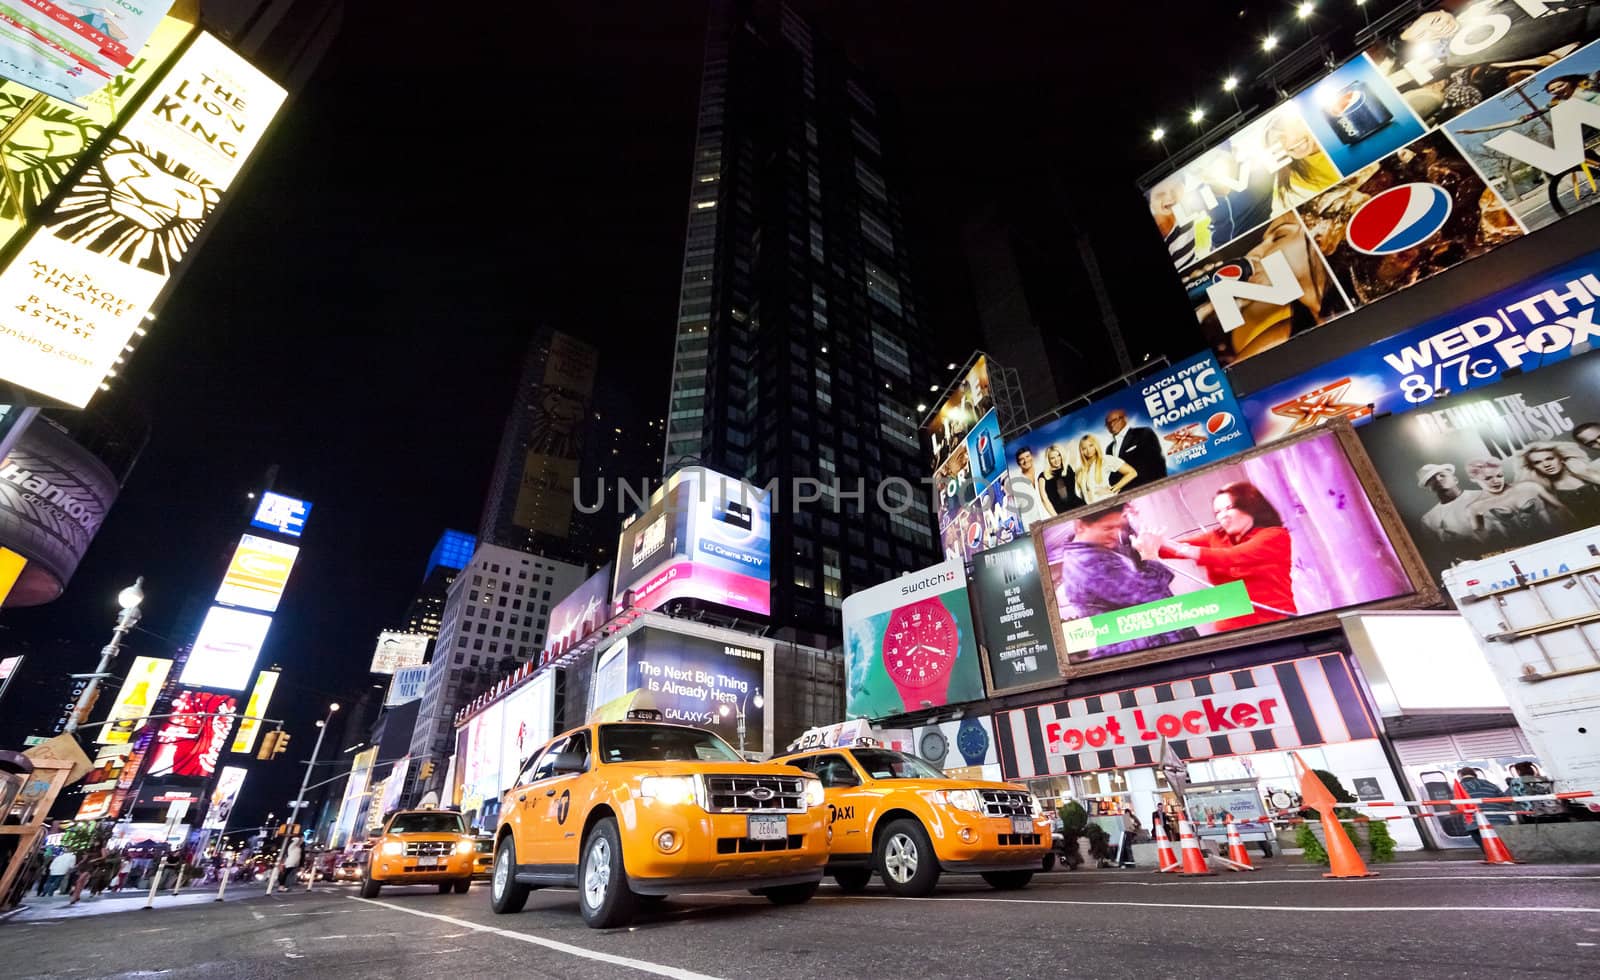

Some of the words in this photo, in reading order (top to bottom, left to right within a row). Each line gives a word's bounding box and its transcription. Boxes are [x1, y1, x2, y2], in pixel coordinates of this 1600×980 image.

[175, 80, 245, 133] LION
[201, 73, 246, 111] THE
[152, 94, 238, 158] KING
[29, 260, 135, 311] MINSKOFF
[33, 269, 122, 317] THEATRE
[15, 305, 67, 330] 45TH
[1495, 308, 1600, 367] FOX
[1142, 376, 1175, 395] CATCH
[1178, 359, 1211, 379] EVERY
[1144, 368, 1220, 417] EPIC
[1153, 390, 1224, 428] MOMENT
[1214, 430, 1242, 446] pepsi
[0, 464, 97, 535] Hankook
[703, 543, 714, 551] LG
[715, 546, 741, 559] Cinema
[902, 574, 945, 596] swatch
[1000, 608, 1034, 624] UNDERWOOD
[1116, 602, 1183, 625] EVERYBODY
[1119, 619, 1155, 634] LOVES
[1156, 604, 1220, 626] RAYMOND
[724, 646, 762, 661] SAMSUNG
[1000, 647, 1028, 661] SUNDAYS
[638, 661, 661, 676] The
[664, 665, 692, 682] Next
[695, 671, 714, 688] Big
[717, 674, 748, 693] Thing
[648, 677, 660, 692] Is
[662, 681, 708, 701] Already
[711, 688, 737, 703] Here
[54, 681, 87, 733] NOVOTEL
[665, 708, 701, 722] GALAXY
[1046, 715, 1125, 754] Foot
[1133, 698, 1277, 742] Locker
